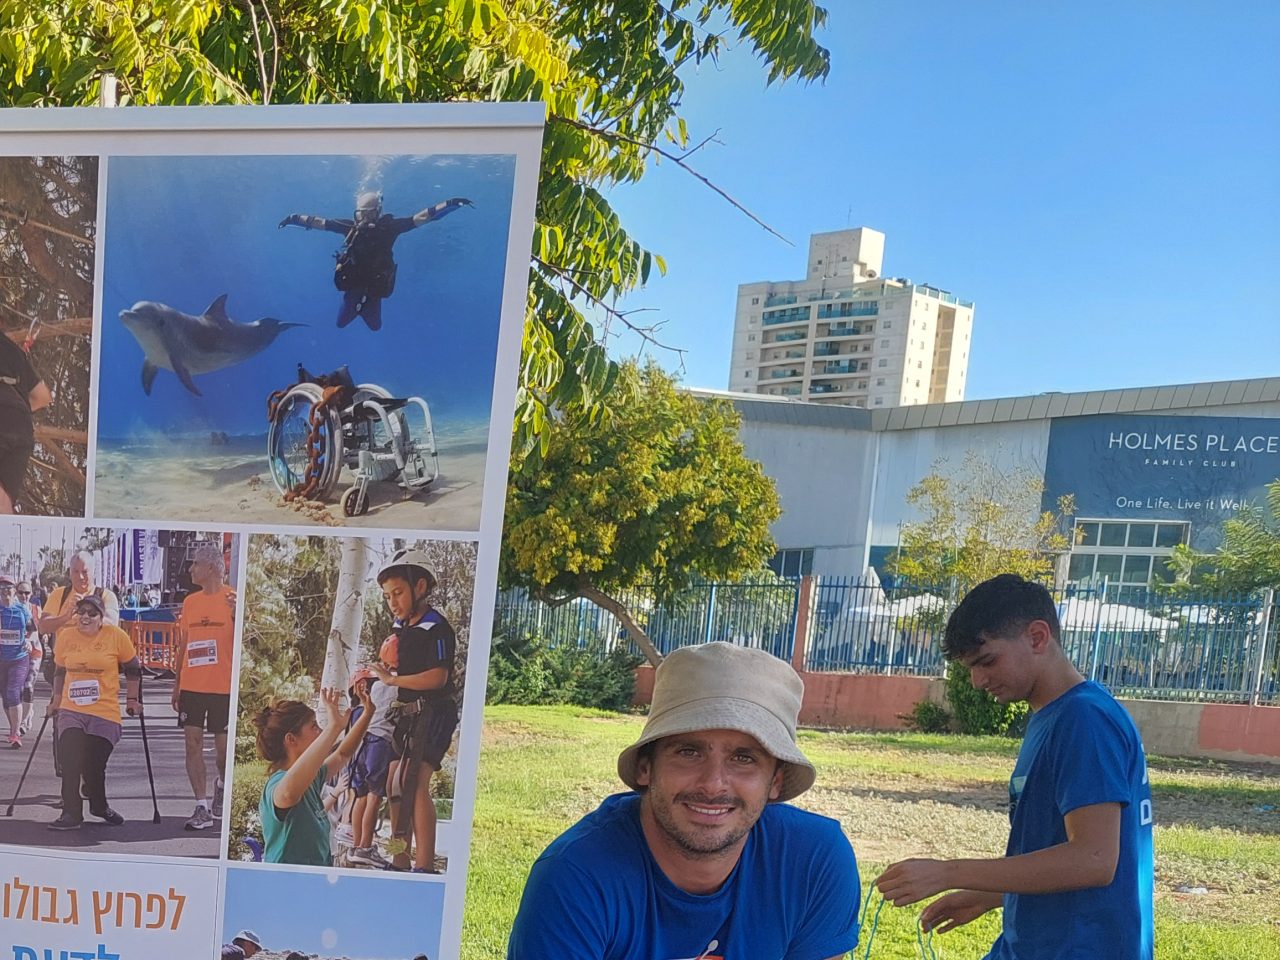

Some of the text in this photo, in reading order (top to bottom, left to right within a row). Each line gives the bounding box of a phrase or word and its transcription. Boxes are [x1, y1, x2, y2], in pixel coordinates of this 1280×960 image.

[1108, 432, 1280, 453] HOLMES PLACE
[1144, 458, 1236, 468] FAMILY CLUB
[1116, 496, 1142, 508] One
[1146, 496, 1173, 509] Life.
[1177, 498, 1201, 510] Live
[1206, 499, 1215, 510] it
[92, 887, 187, 935] לפרוץ
